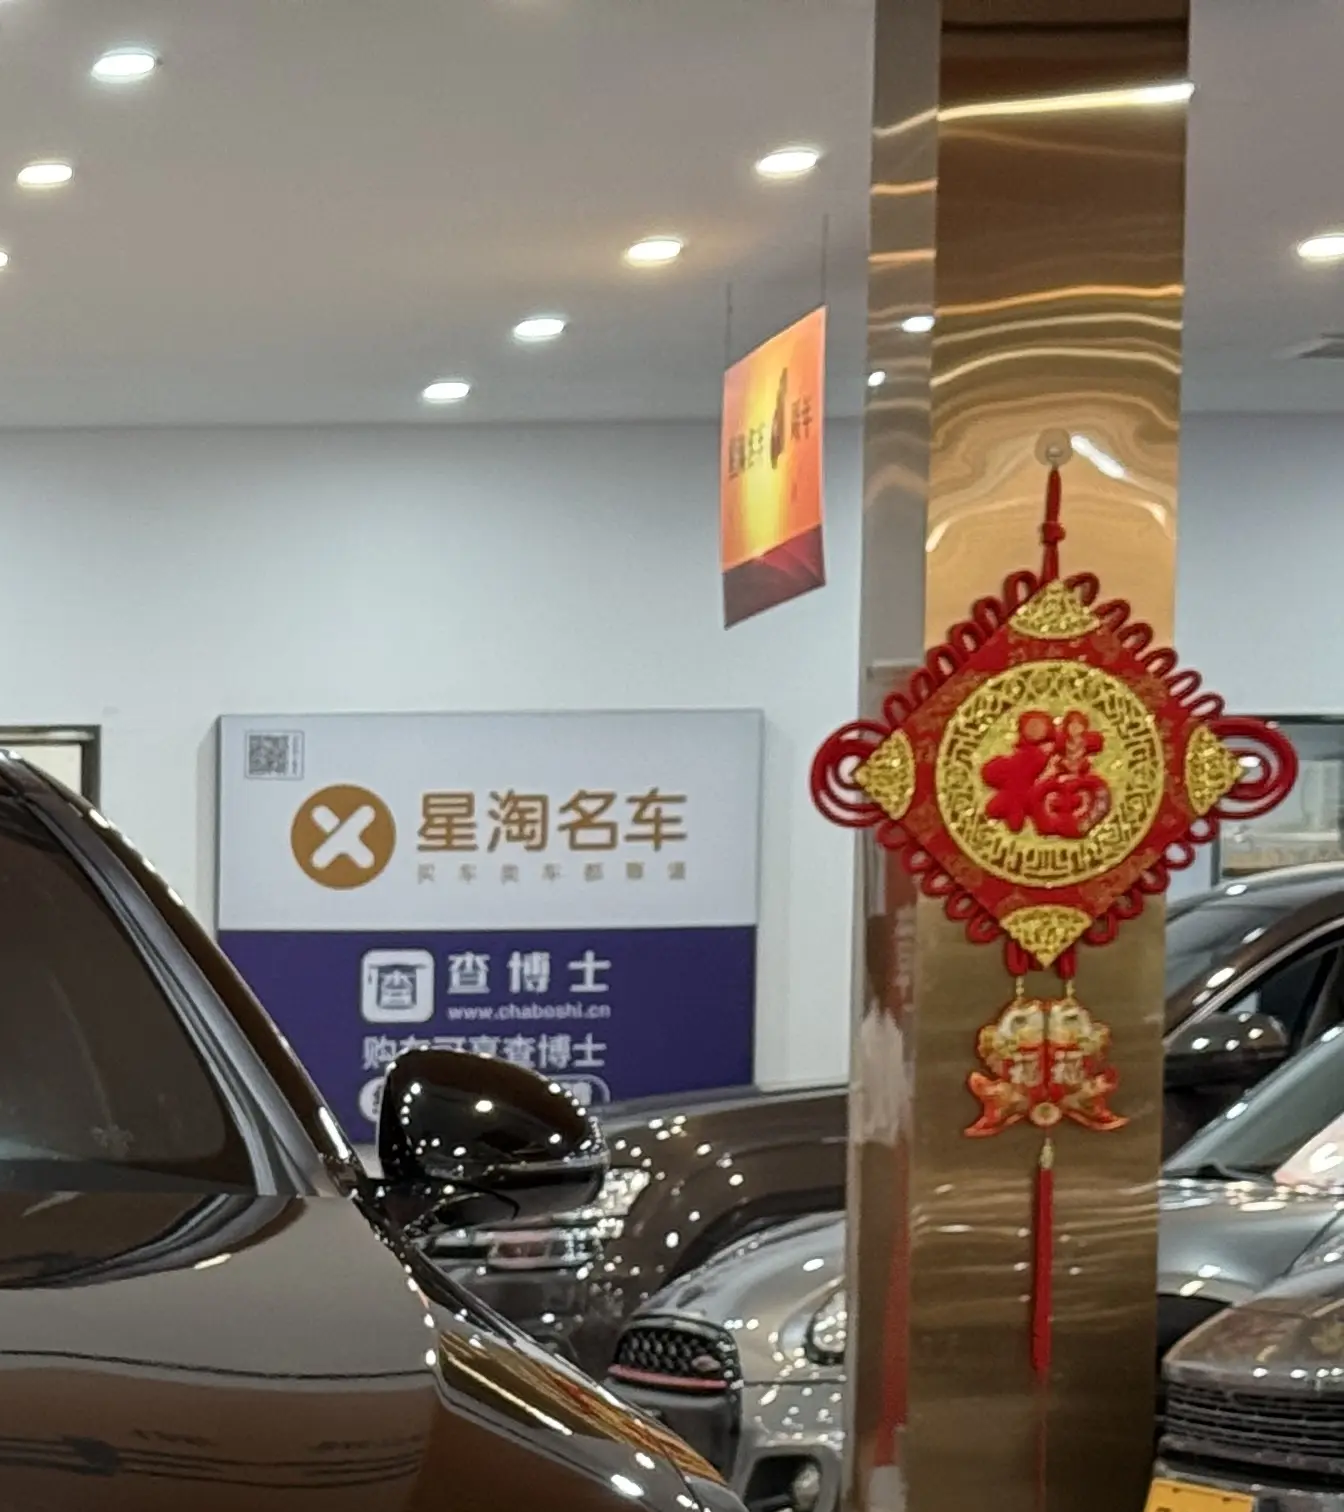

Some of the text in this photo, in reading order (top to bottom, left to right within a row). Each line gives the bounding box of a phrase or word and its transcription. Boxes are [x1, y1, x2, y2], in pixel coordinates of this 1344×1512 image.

[416, 787, 688, 853] 星淘名车
[447, 950, 612, 994] 查博士
[447, 1001, 611, 1021] www.chaboshi.cn
